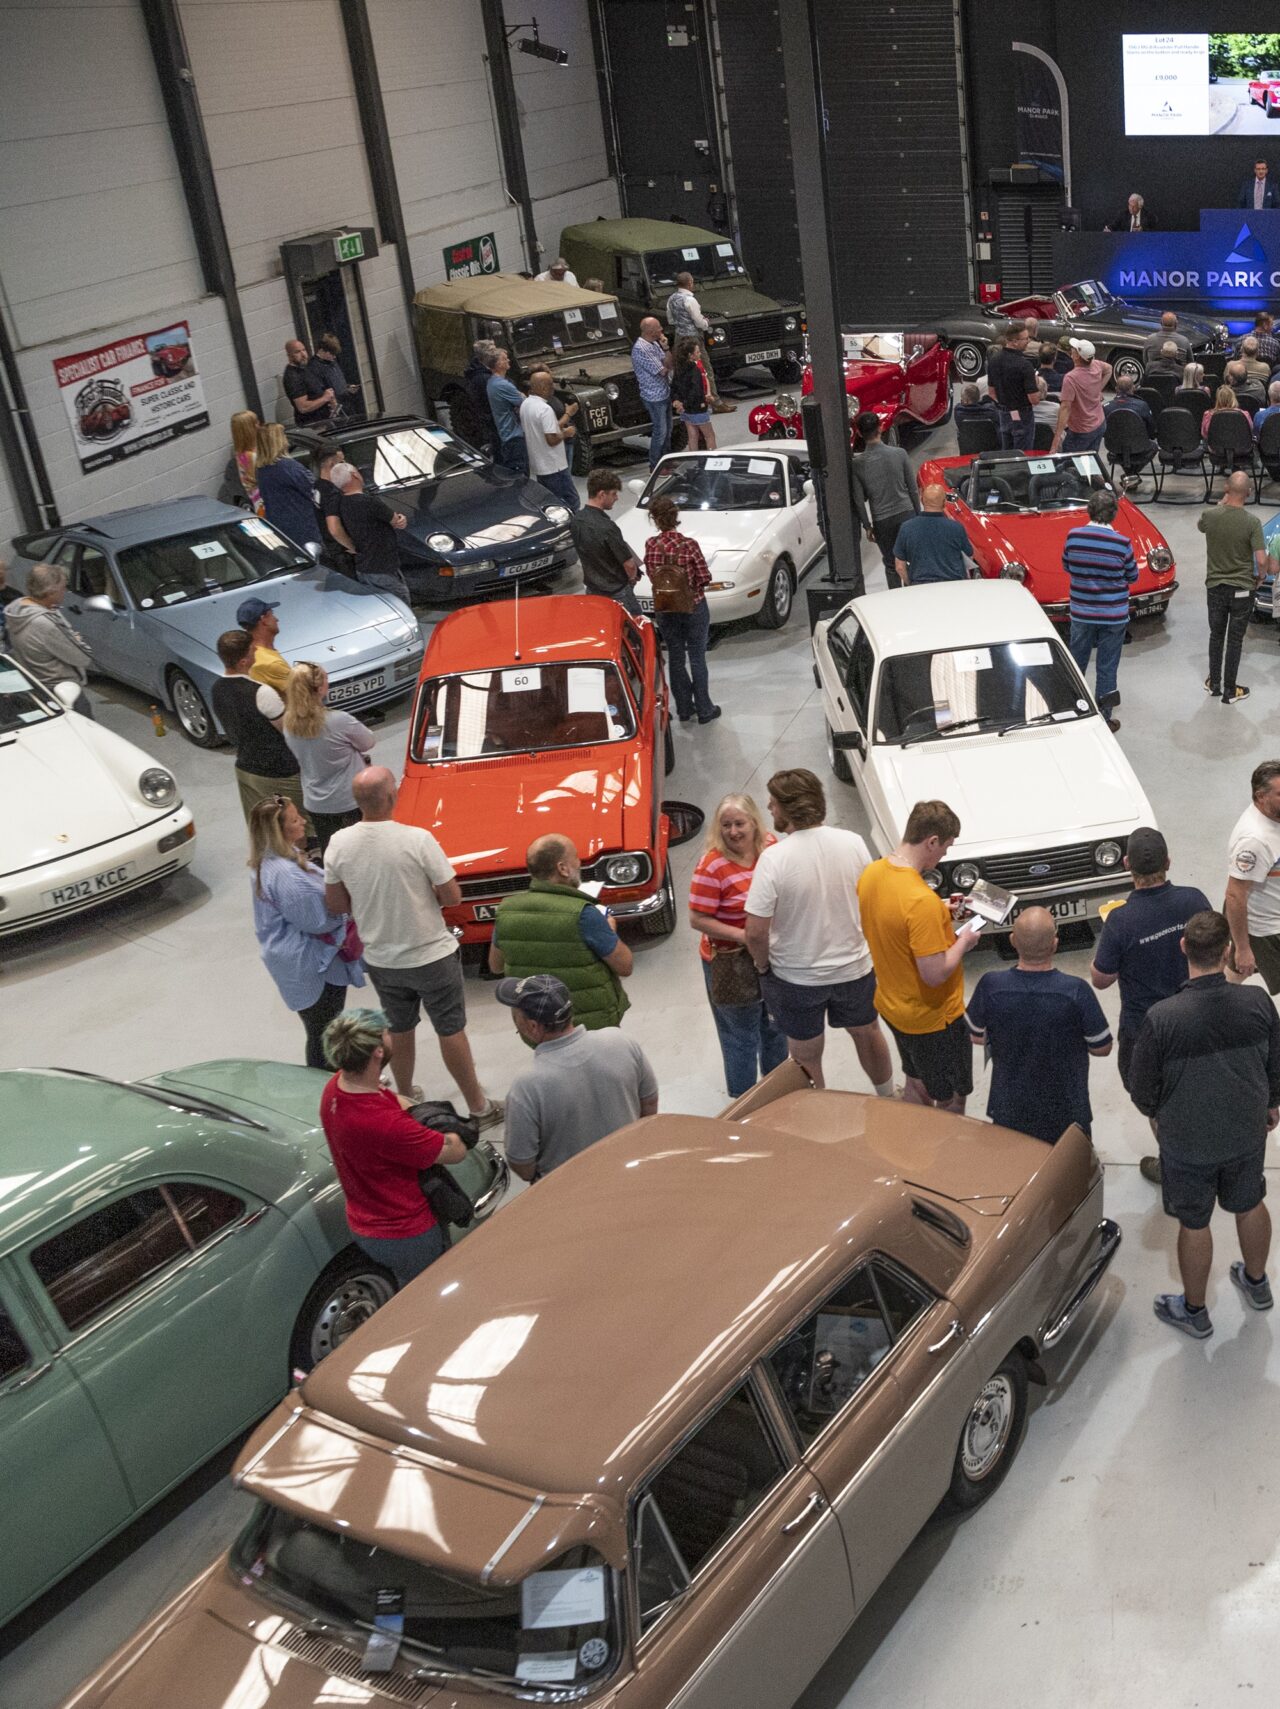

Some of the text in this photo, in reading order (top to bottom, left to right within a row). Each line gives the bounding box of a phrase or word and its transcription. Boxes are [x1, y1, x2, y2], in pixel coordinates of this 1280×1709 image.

[1017, 106, 1059, 116] MANOR PARK
[1119, 270, 1200, 288] MANOR
[1206, 271, 1263, 288] PARK
[58, 338, 147, 383] SPECIALIST CAR FINANCE
[140, 380, 197, 407] SUPER CLASSIC AND
[176, 393, 192, 406] CARS
[592, 416, 609, 428] 187
[201, 546, 216, 554] 73
[514, 675, 529, 686] 60
[328, 675, 385, 702] G256 YPD
[51, 867, 129, 905] H212 KCC
